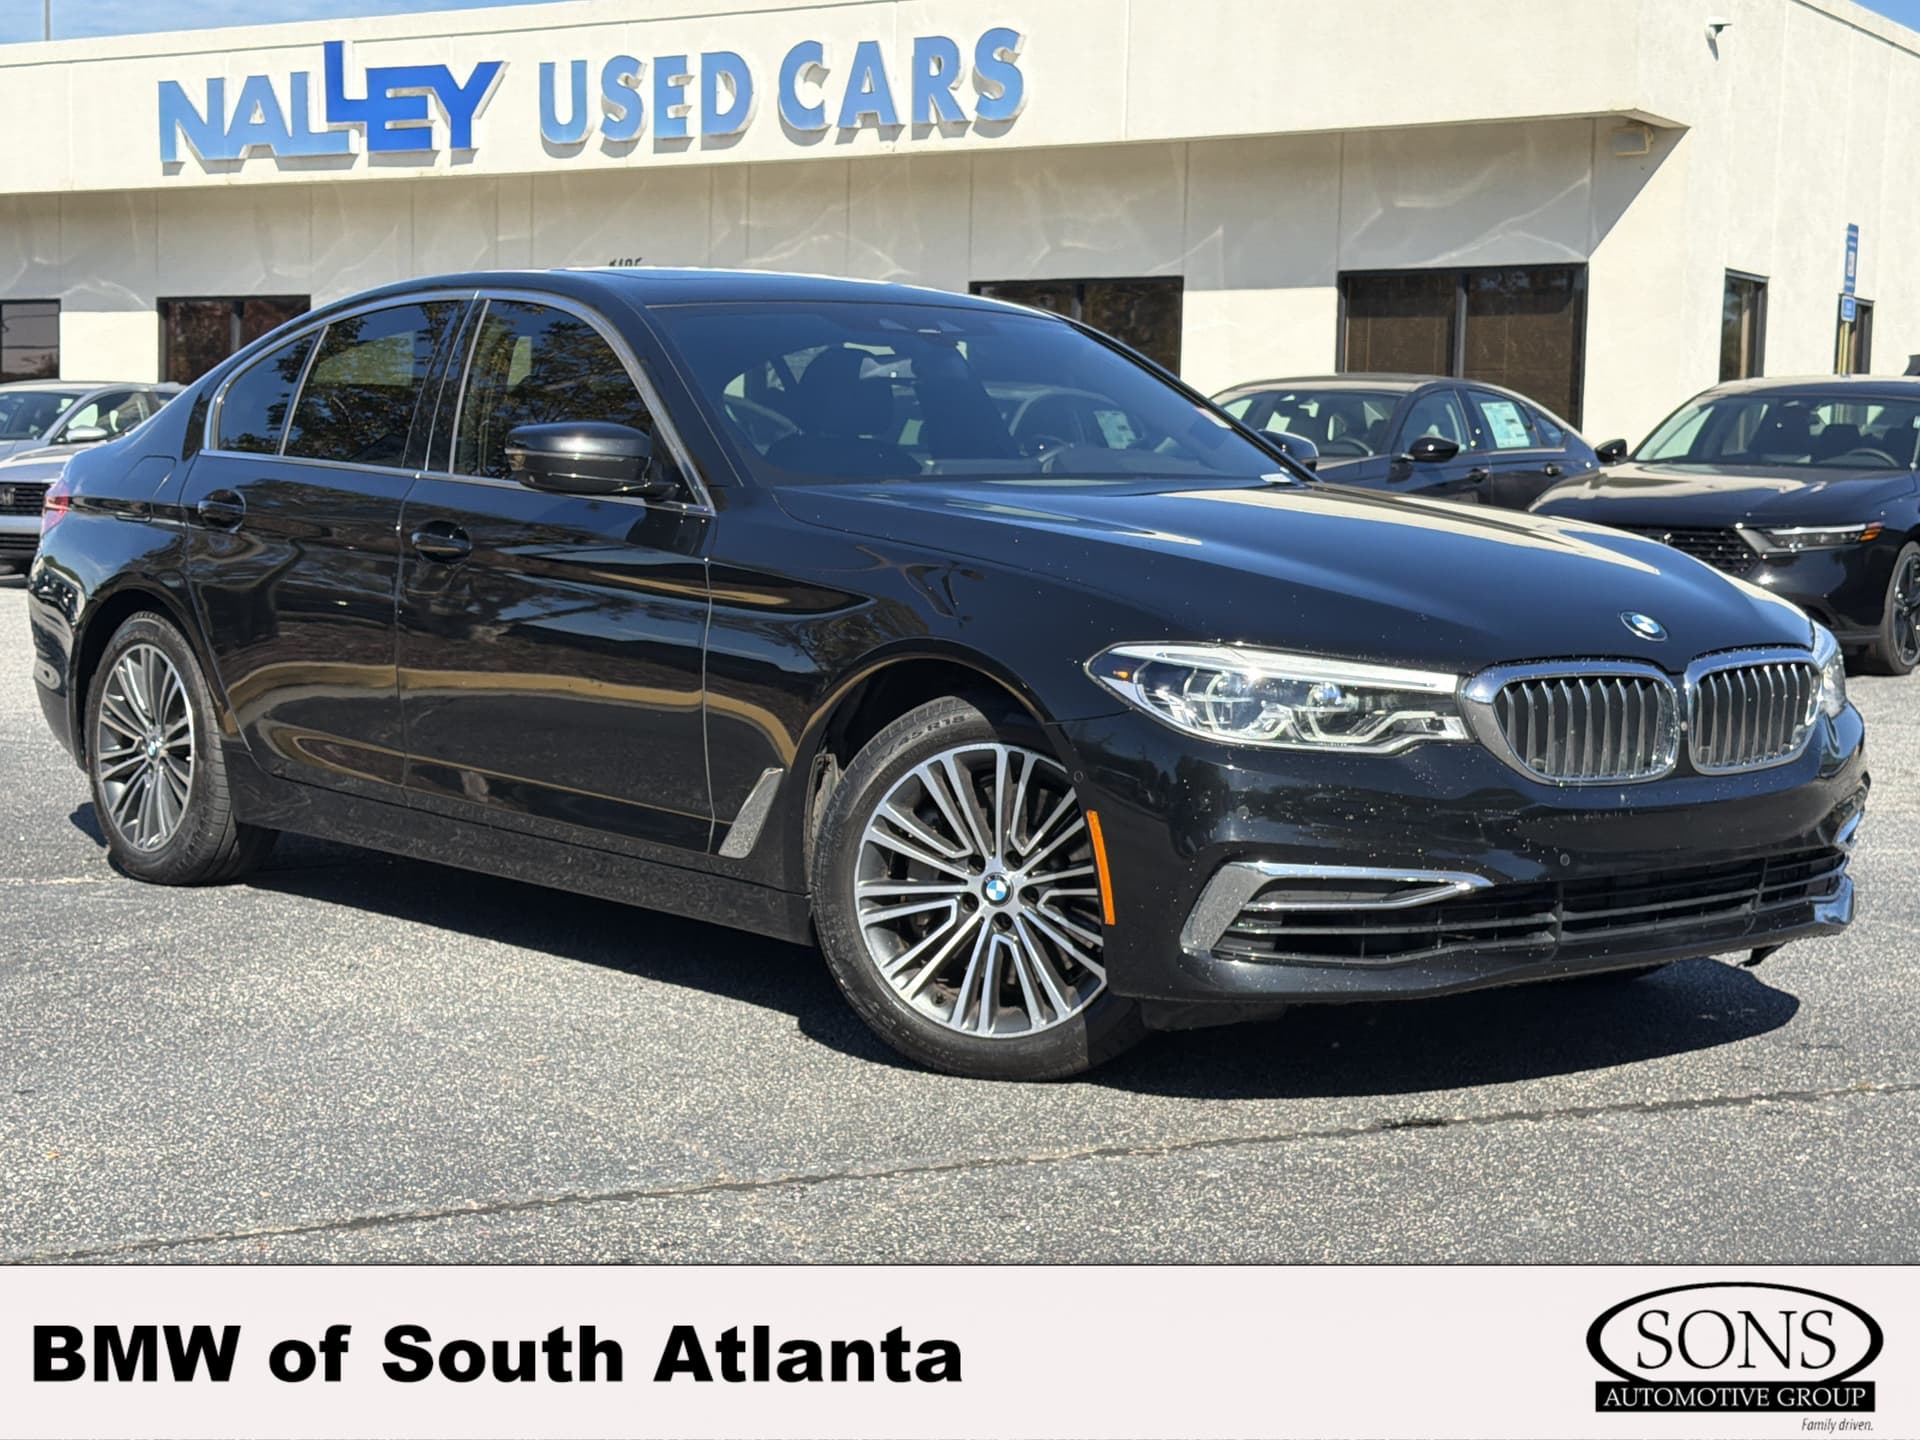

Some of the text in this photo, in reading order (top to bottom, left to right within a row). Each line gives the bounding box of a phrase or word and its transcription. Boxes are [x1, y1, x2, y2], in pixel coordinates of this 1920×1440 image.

[158, 28, 1025, 162] NALLEY USED CARS
